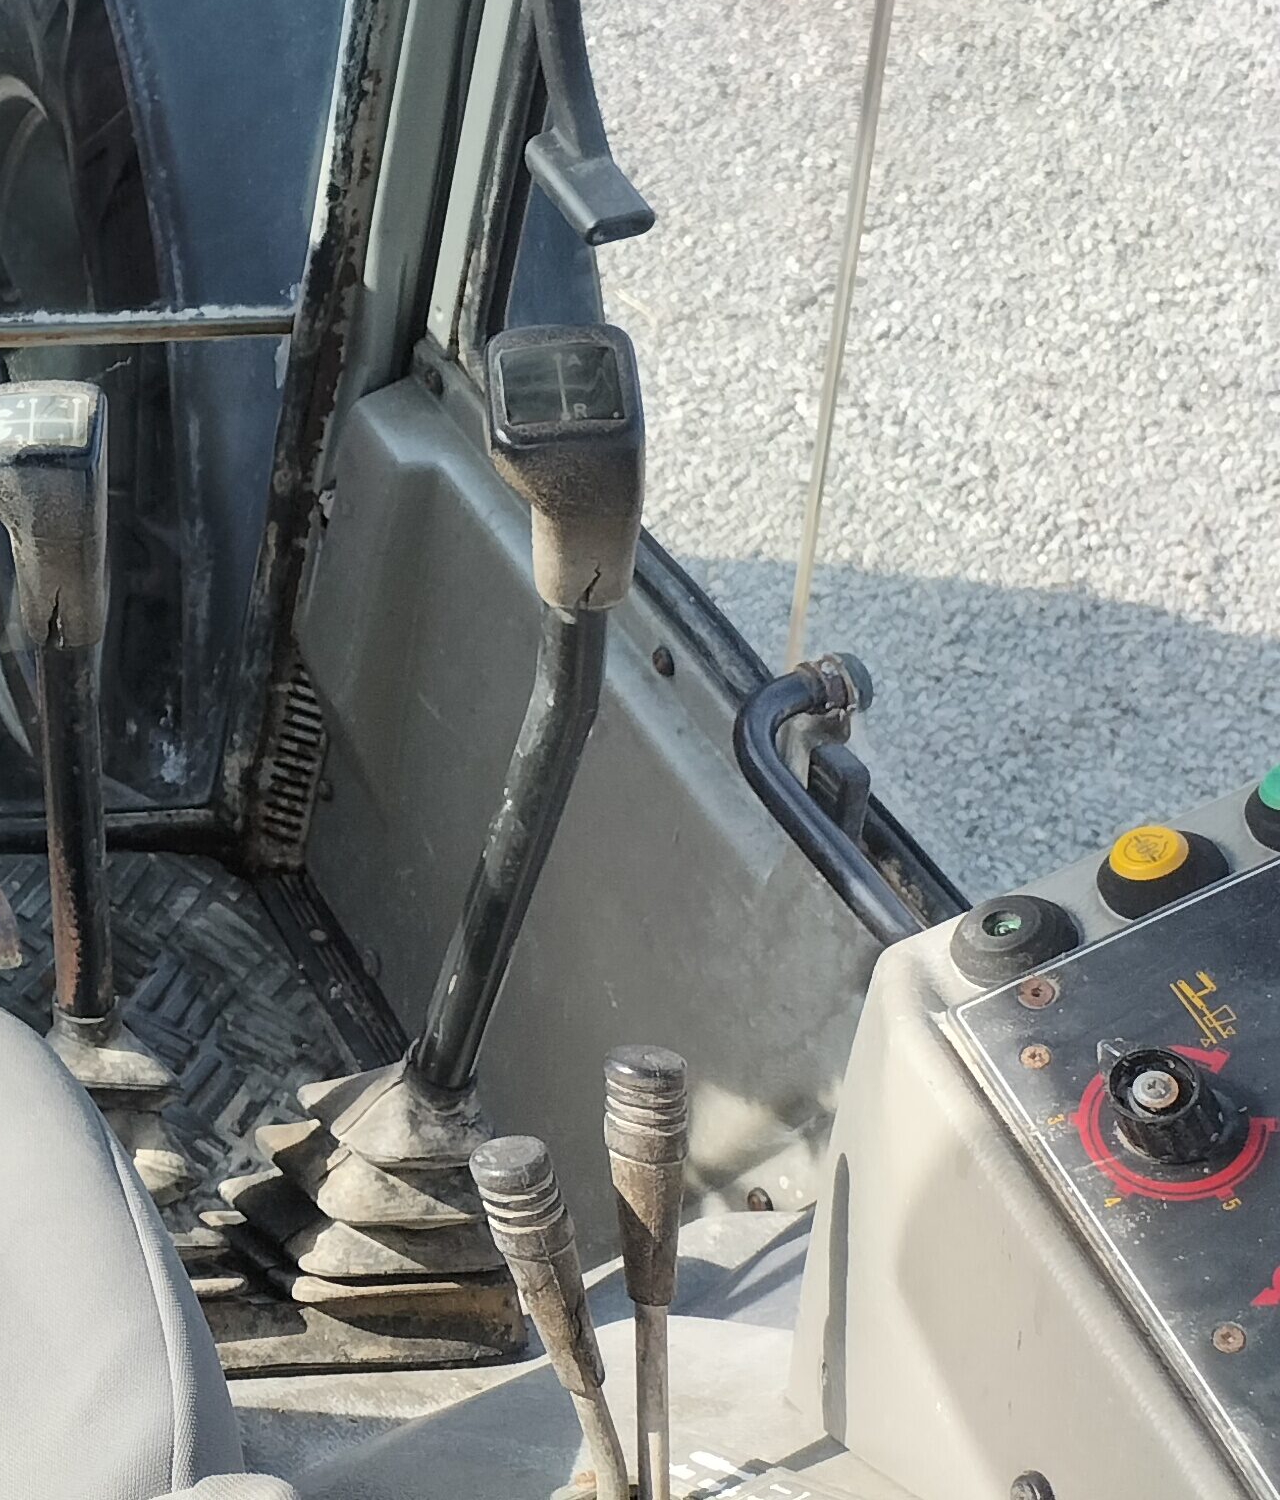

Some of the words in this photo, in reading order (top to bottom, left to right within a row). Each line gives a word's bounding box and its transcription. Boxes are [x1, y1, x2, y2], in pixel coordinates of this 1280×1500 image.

[573, 403, 588, 419] R
[1047, 1113, 1065, 1126] 3
[1103, 1197, 1122, 1208] 4
[1222, 1197, 1243, 1211] 5
